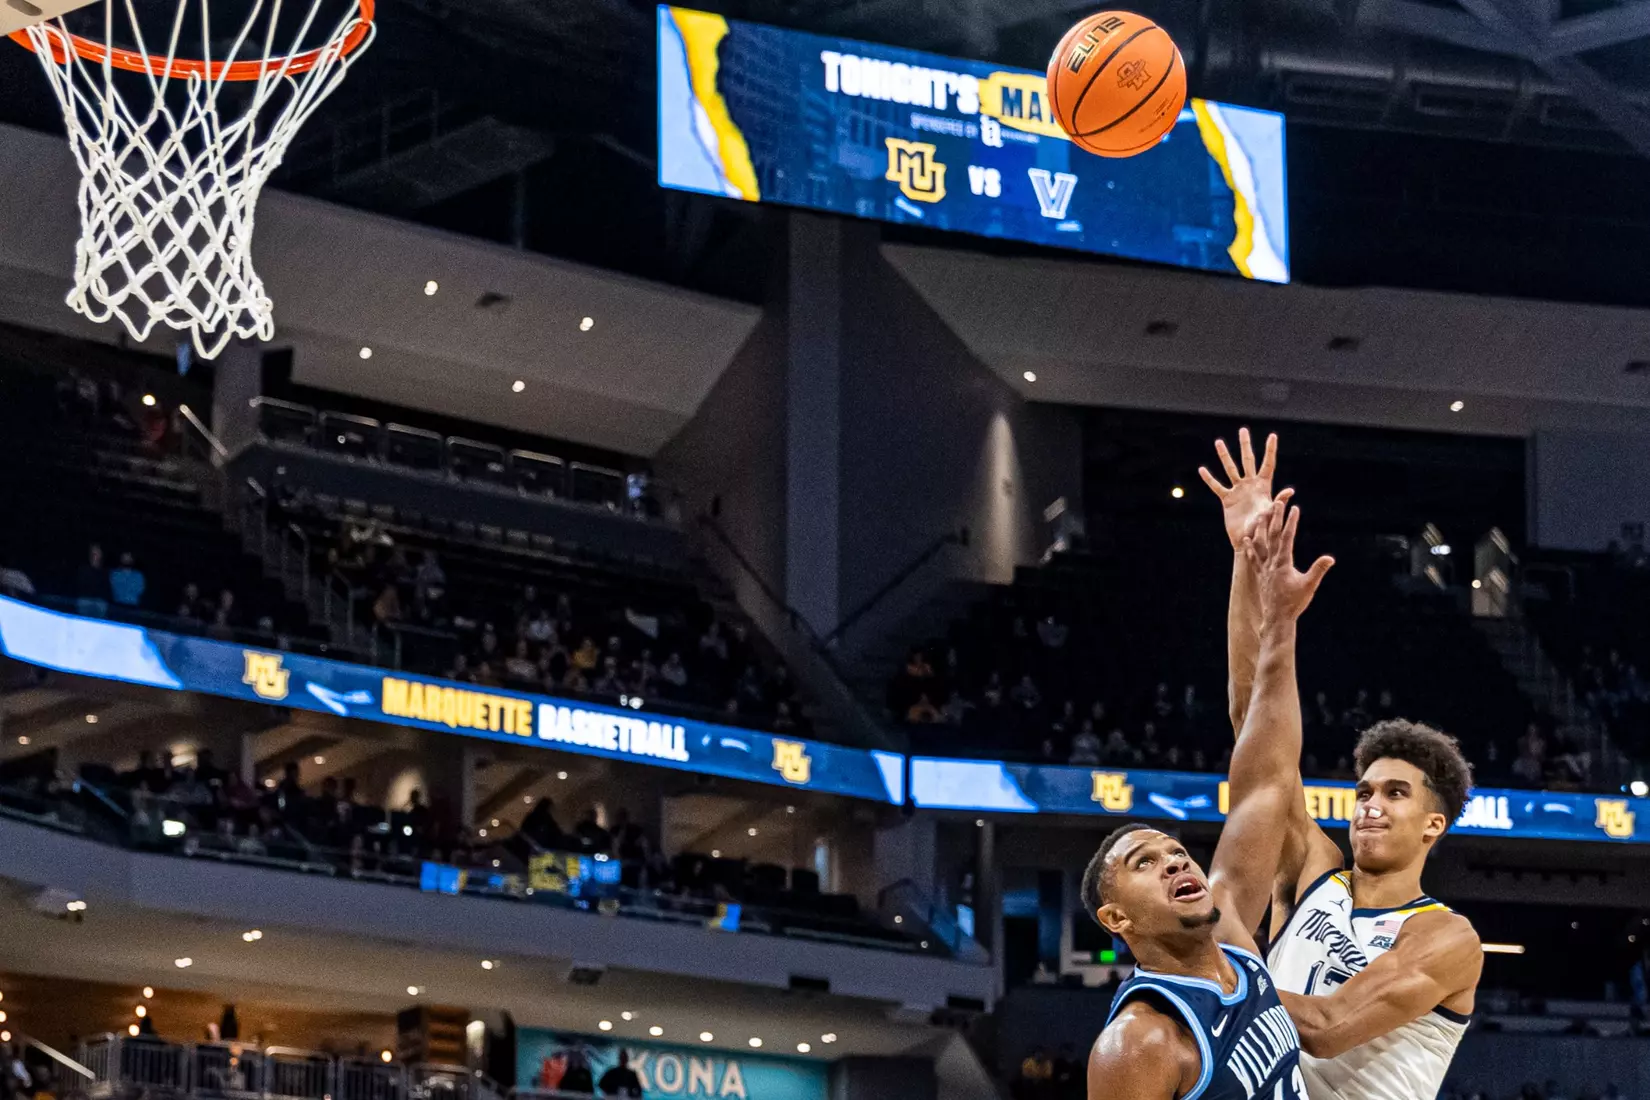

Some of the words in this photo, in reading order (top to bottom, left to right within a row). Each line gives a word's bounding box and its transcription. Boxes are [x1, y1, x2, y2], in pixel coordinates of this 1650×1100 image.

[1066, 16, 1125, 74] ELITE
[821, 50, 980, 115] TONIGHT'S
[1001, 85, 1057, 125] MA
[885, 137, 947, 204] MU
[1027, 168, 1079, 220] V
[242, 650, 290, 701] MU
[381, 677, 533, 737] MARQUETTE
[538, 704, 690, 762] BASKETBALL
[772, 738, 812, 784] MU
[1091, 770, 1134, 812] MU
[1594, 799, 1636, 839] MU
[1295, 908, 1368, 973] Marque
[626, 1048, 746, 1099] KONA
